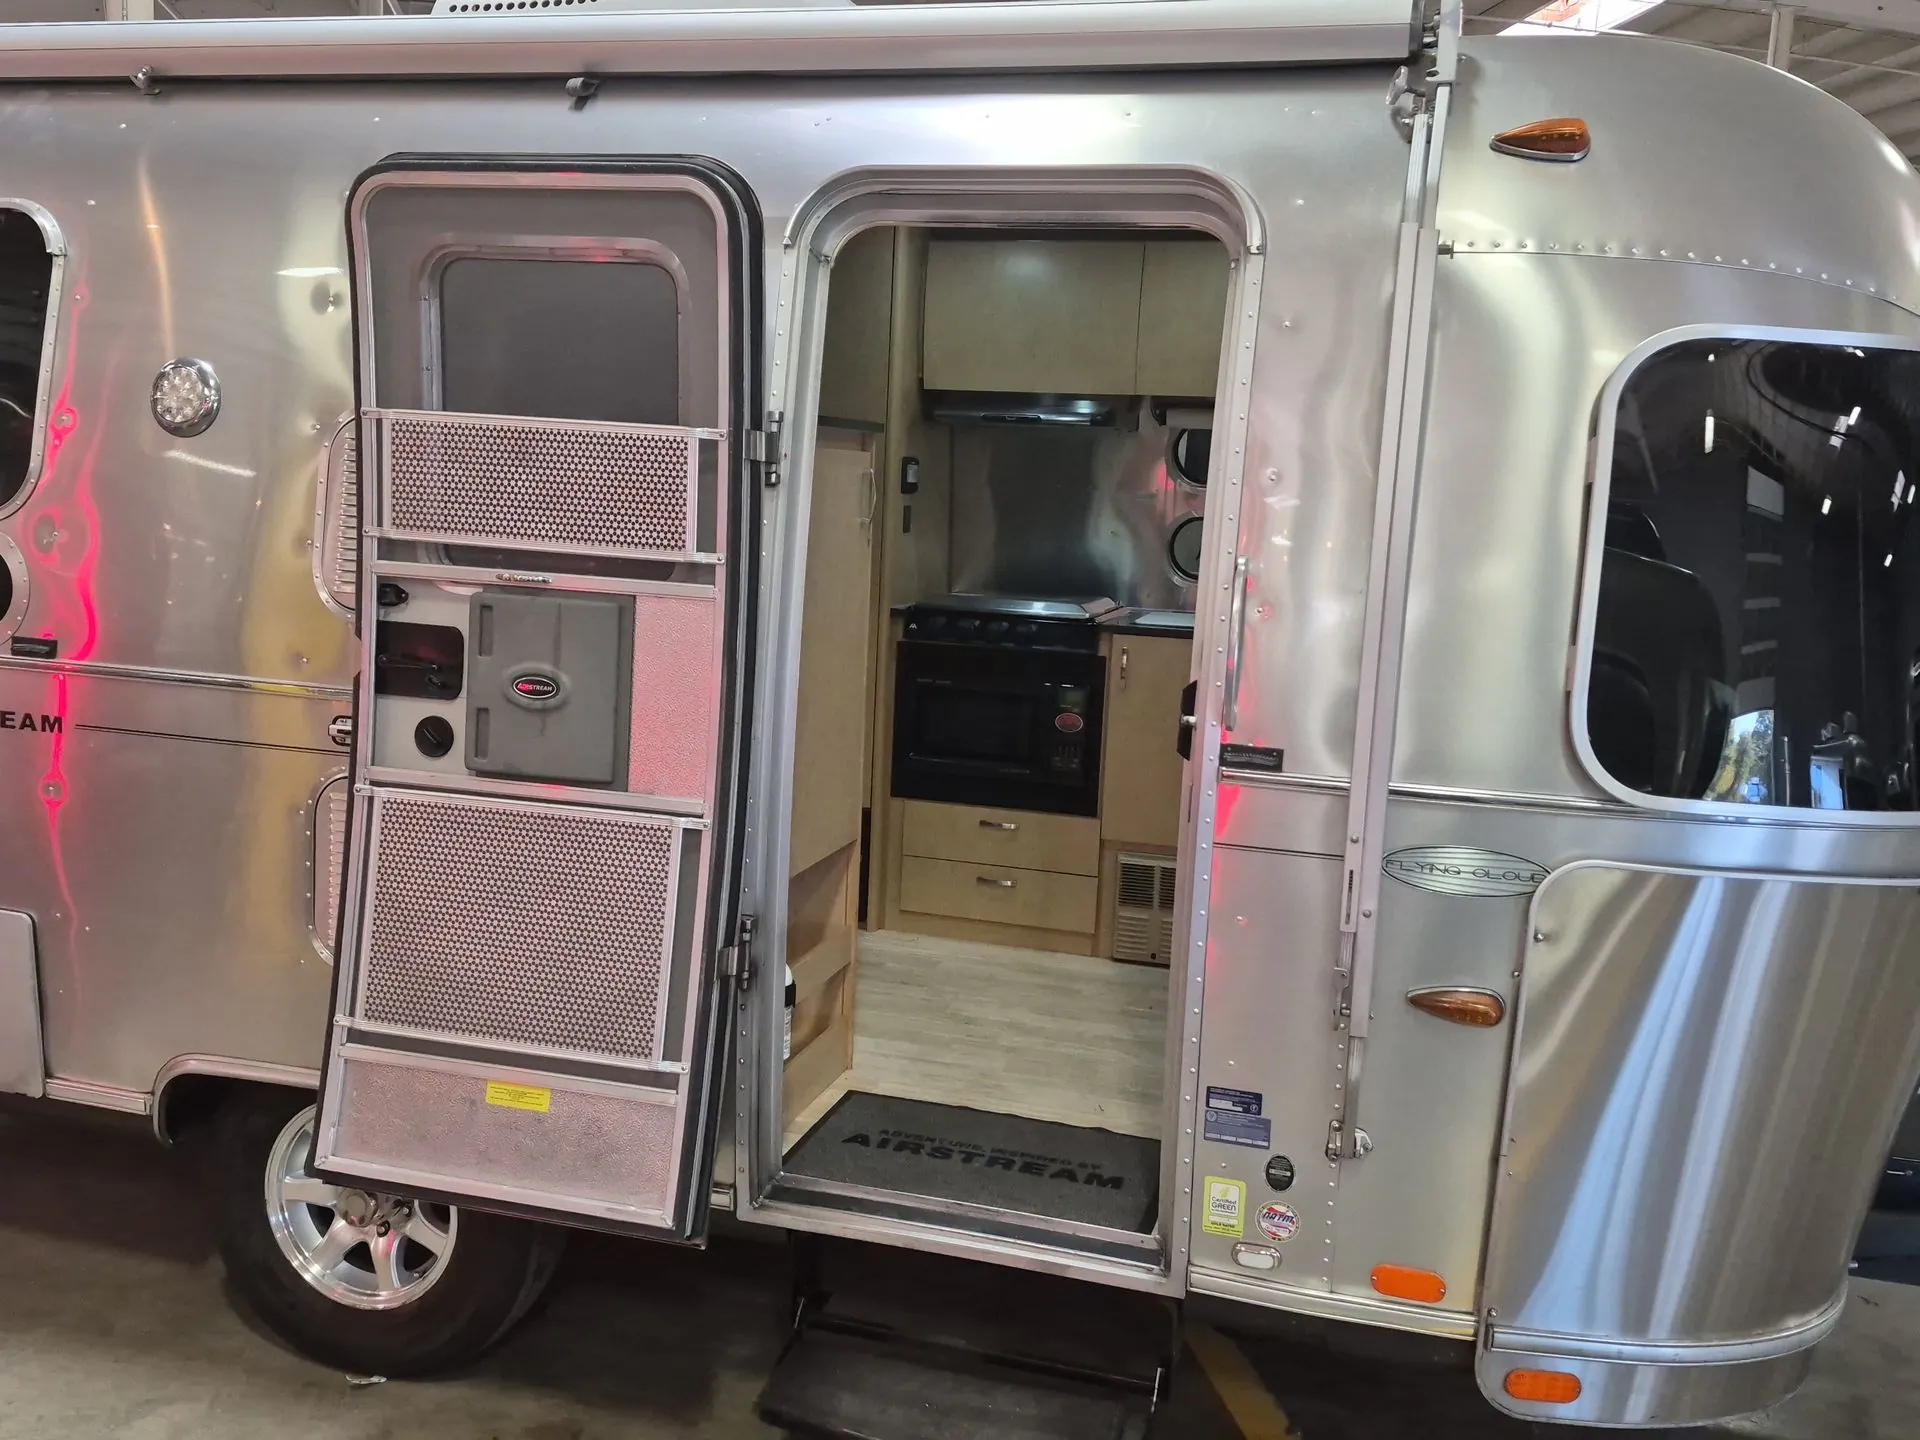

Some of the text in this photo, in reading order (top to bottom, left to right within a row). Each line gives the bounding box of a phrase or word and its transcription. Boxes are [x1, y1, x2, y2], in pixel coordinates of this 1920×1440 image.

[0, 710, 63, 734] EAM
[1385, 859, 1461, 876] FLYING
[841, 1132, 1124, 1190] AIRSTREAM
